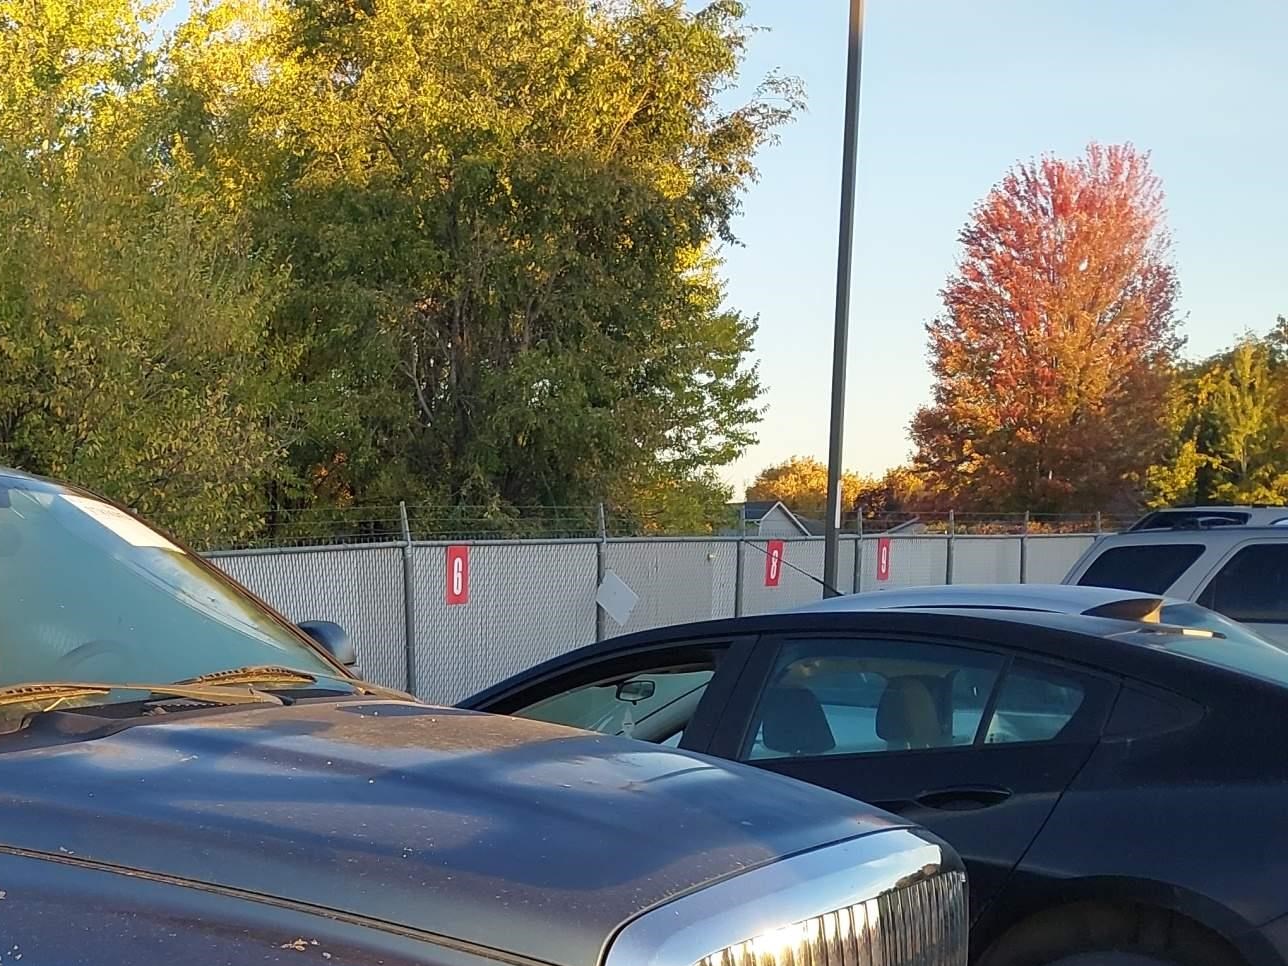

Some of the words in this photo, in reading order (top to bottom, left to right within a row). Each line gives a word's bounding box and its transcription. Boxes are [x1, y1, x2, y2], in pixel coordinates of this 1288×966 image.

[770, 549, 779, 580] 8
[880, 546, 888, 574] 9
[453, 556, 463, 596] 6
